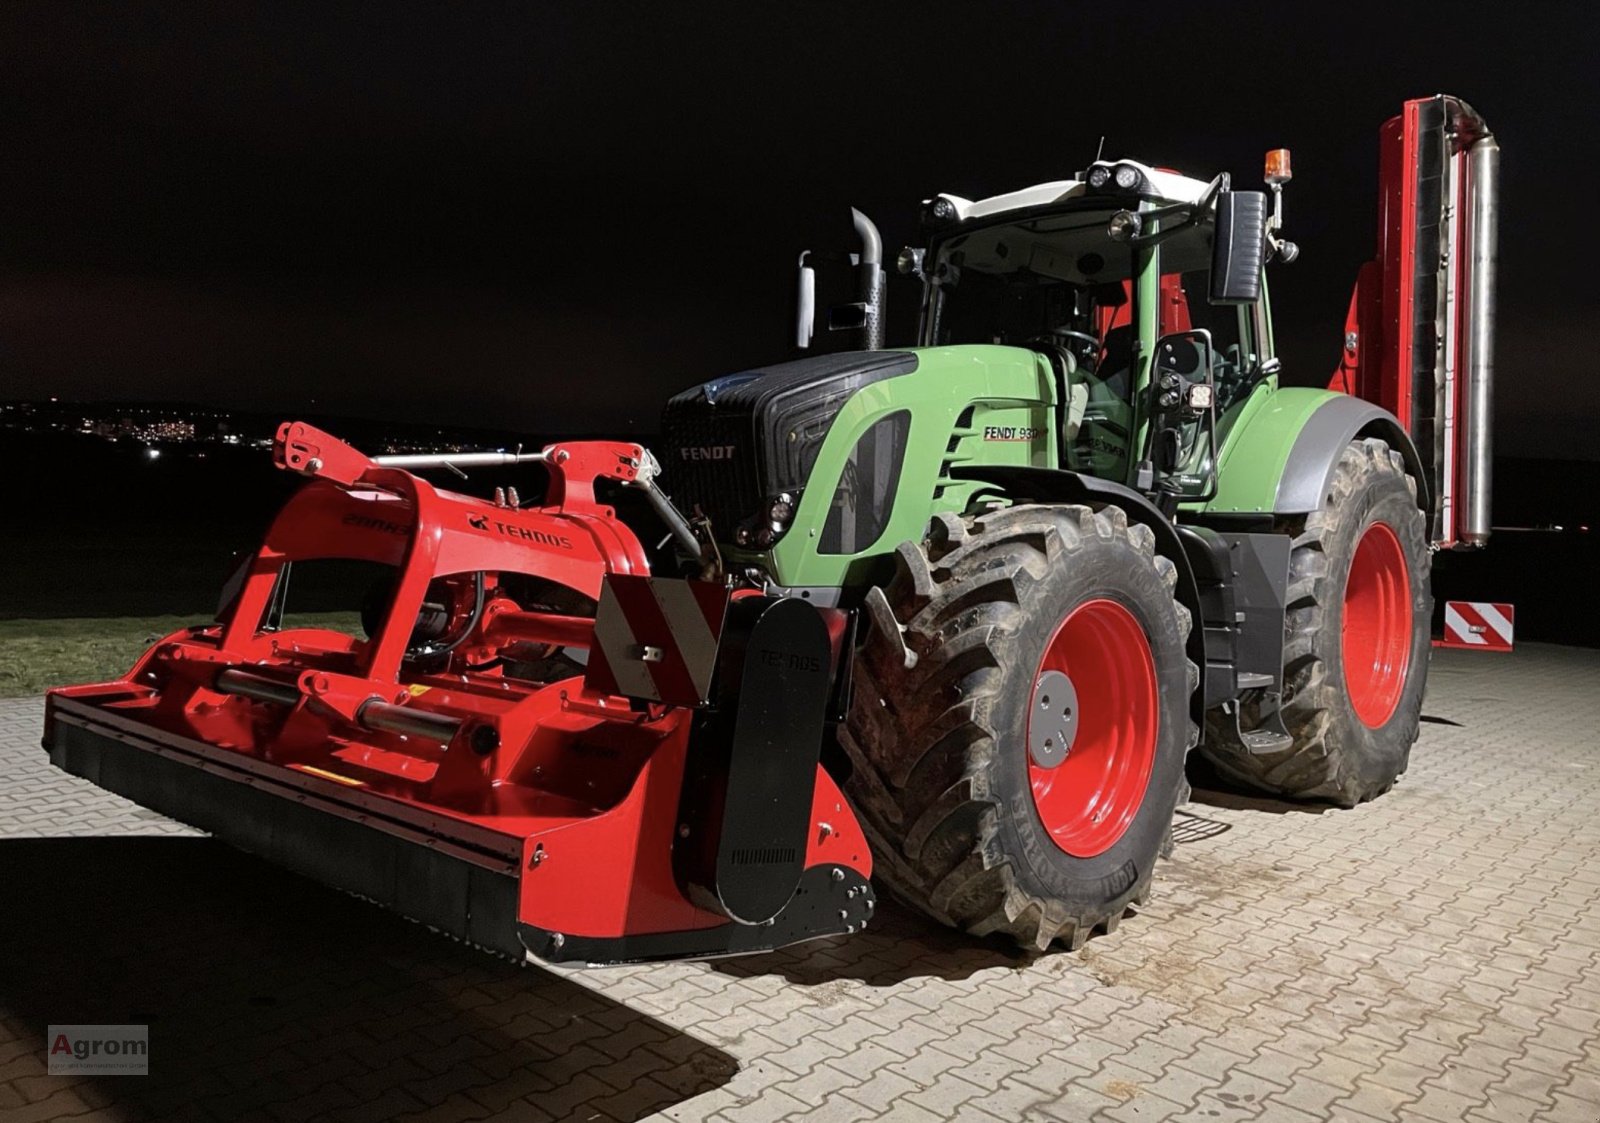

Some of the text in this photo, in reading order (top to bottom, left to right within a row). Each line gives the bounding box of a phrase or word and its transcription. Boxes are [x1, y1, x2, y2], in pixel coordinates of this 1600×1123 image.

[984, 426, 1016, 439] FENDT
[680, 445, 735, 461] FENDT
[495, 521, 573, 550] TEHNOS
